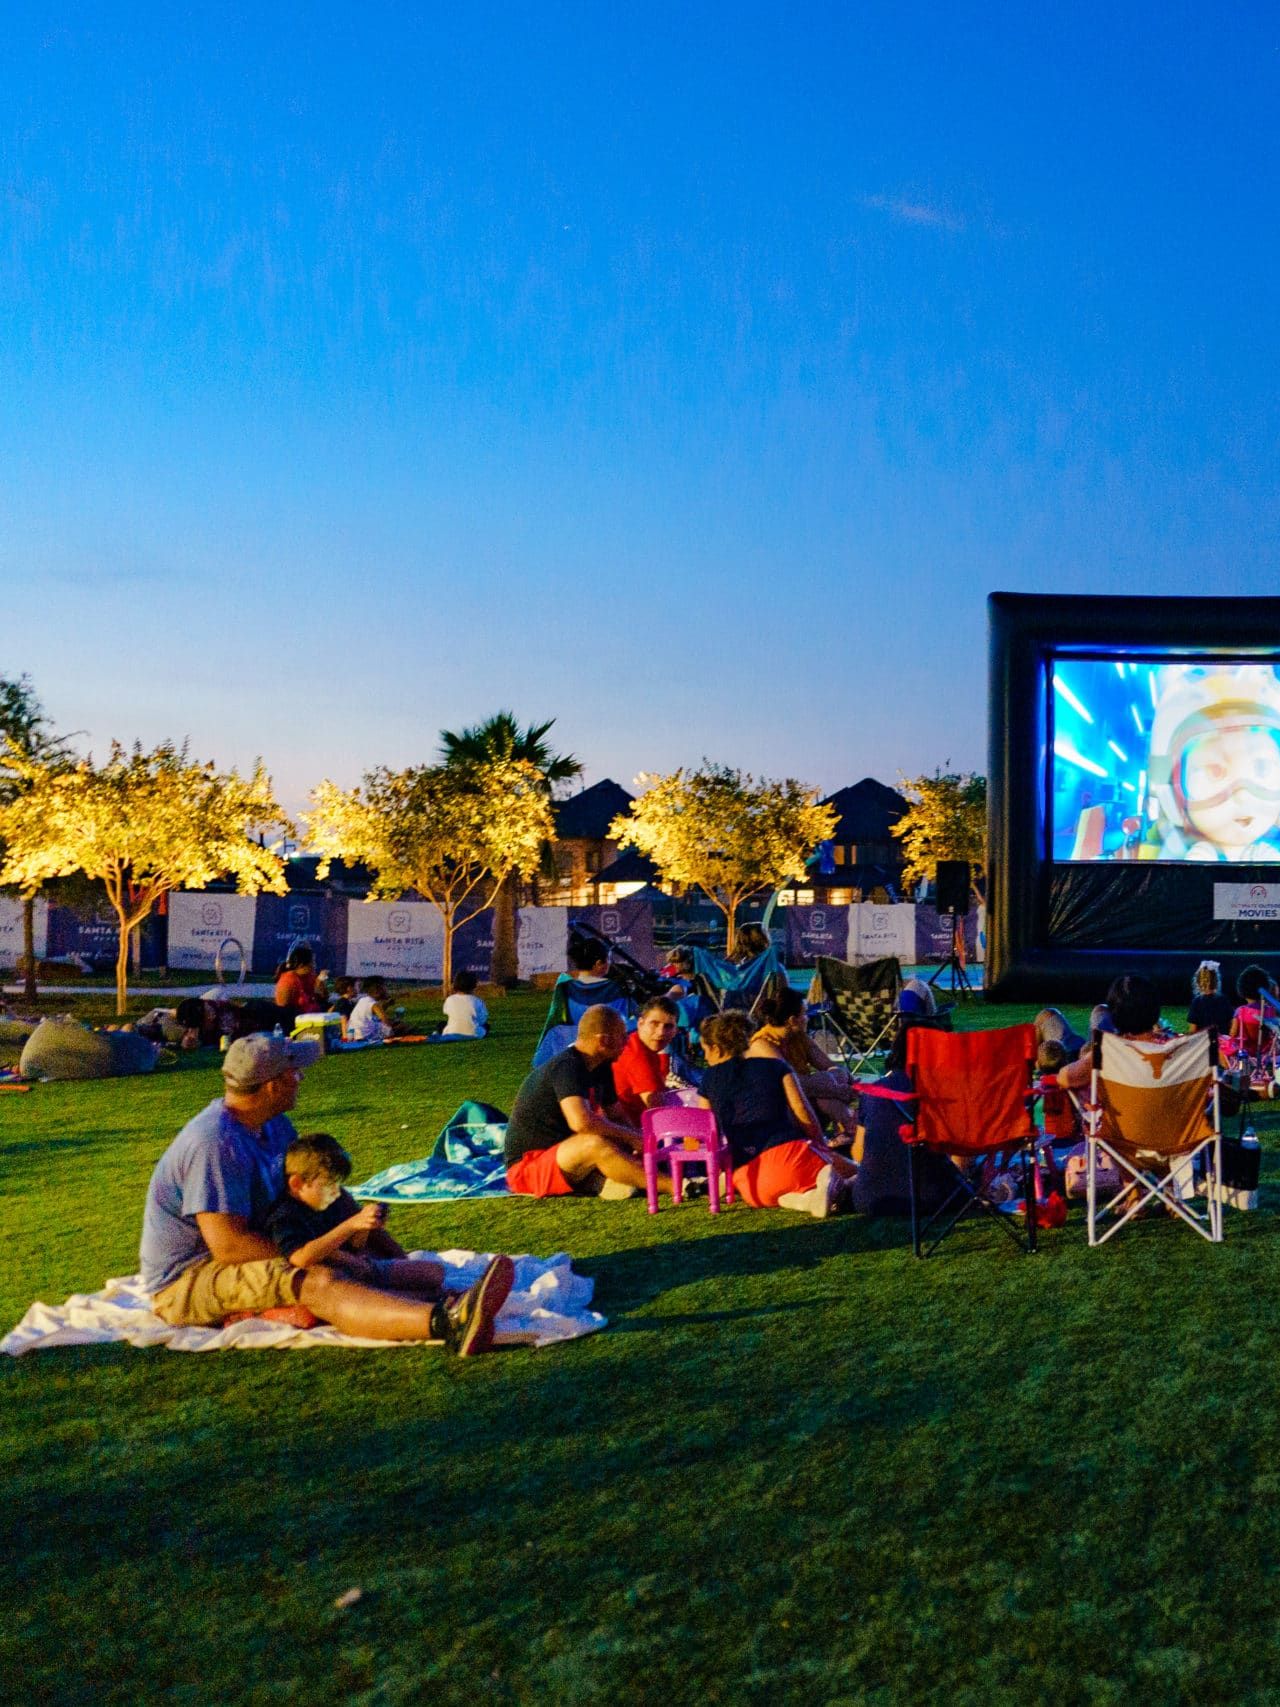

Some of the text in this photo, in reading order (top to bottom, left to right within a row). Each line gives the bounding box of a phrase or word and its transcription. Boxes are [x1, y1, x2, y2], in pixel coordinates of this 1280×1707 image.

[1238, 909, 1278, 918] MOVIES
[78, 926, 113, 935] SANTA
[373, 936, 425, 946] SANTA RITA
